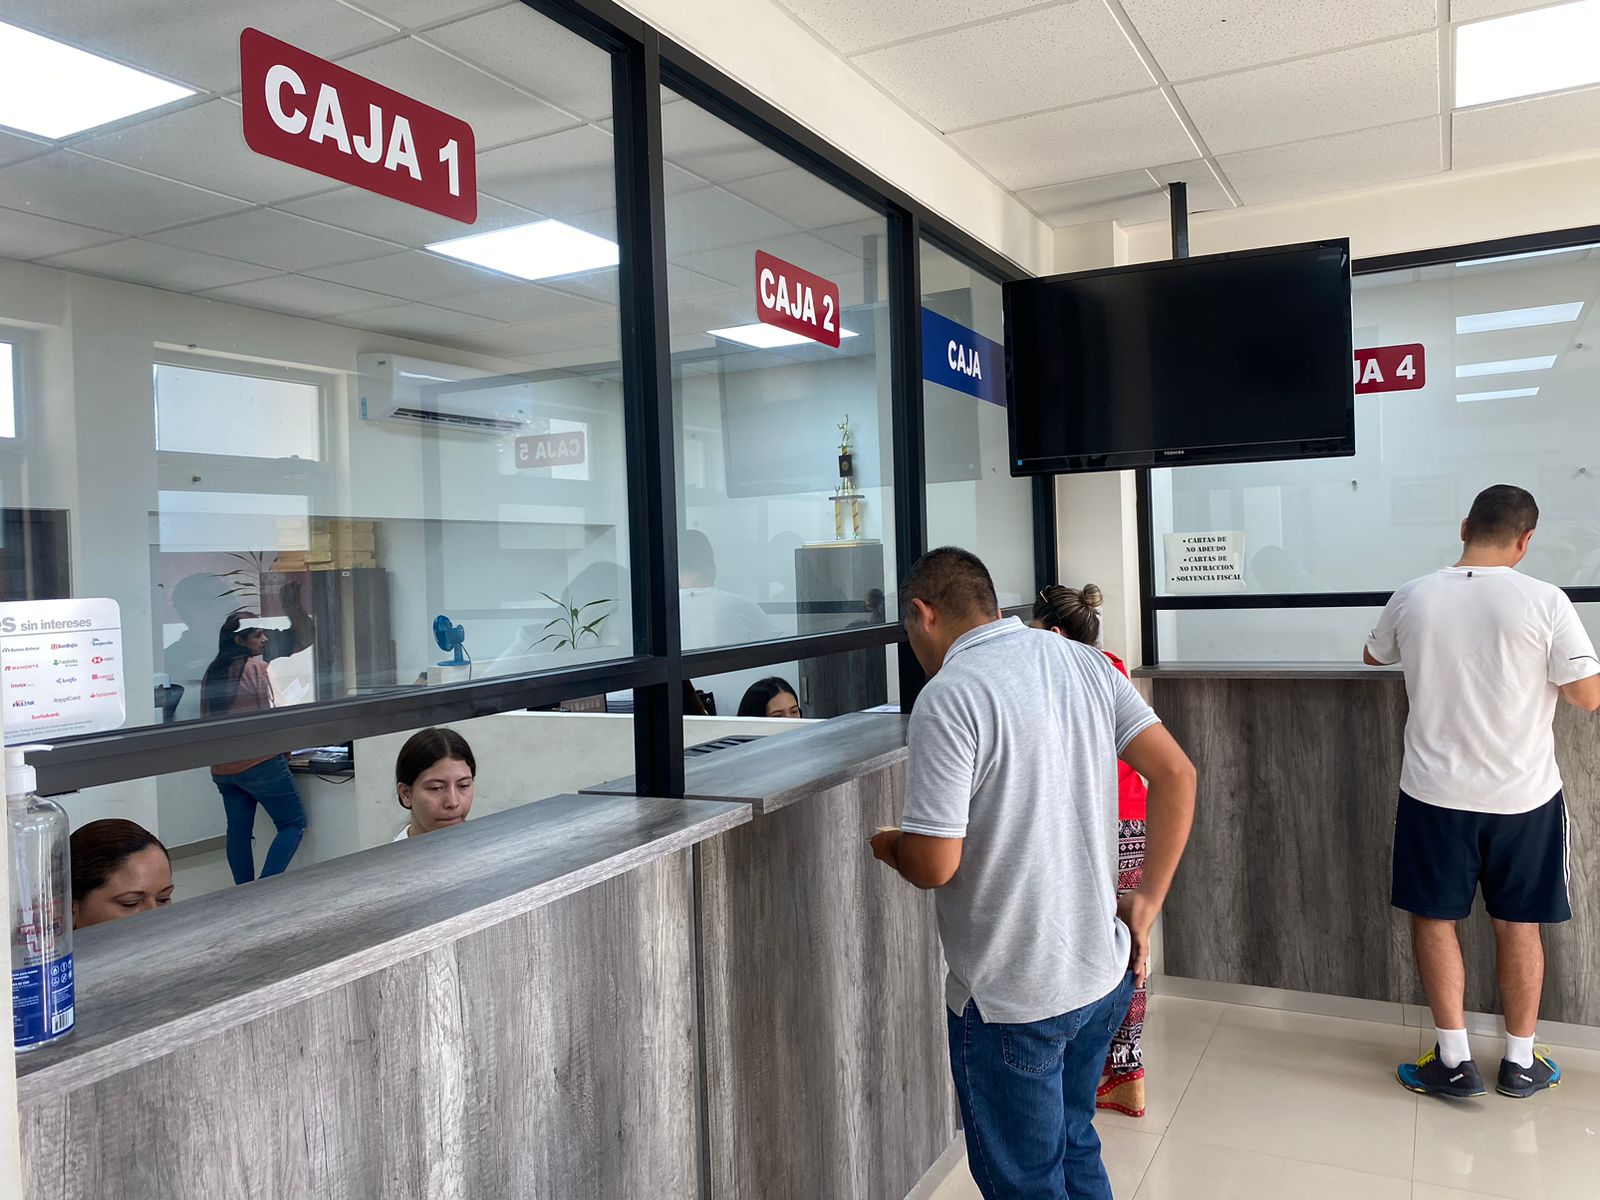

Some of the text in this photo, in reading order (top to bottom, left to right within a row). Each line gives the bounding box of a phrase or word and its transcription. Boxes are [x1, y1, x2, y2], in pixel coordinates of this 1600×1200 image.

[264, 64, 461, 198] CAJA 1
[759, 268, 836, 333] CAJA 2
[947, 339, 982, 380] CAJA
[1396, 354, 1416, 380] 4
[1187, 535, 1227, 544] CARTAS DE
[1197, 545, 1227, 553] ADEUDO
[1188, 555, 1217, 563] CARTAS
[1190, 564, 1234, 572] INFRACCION
[0, 616, 93, 633] s sin intereses
